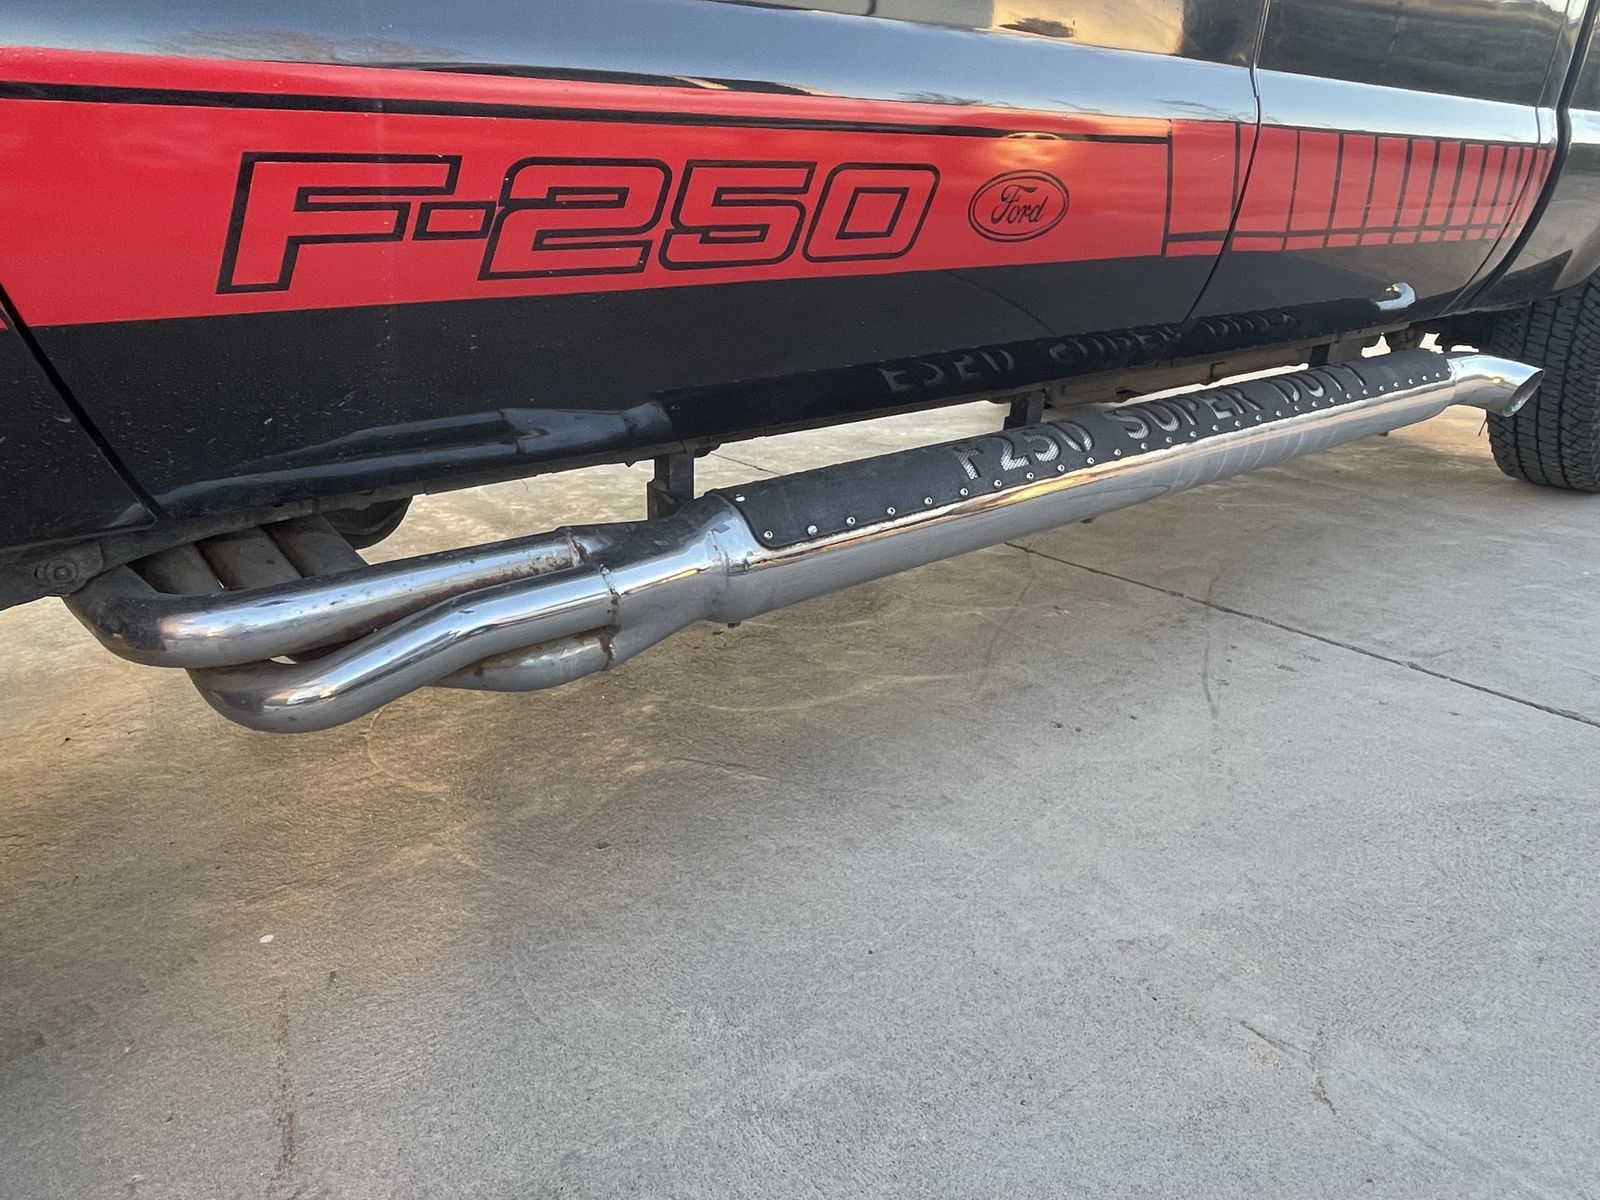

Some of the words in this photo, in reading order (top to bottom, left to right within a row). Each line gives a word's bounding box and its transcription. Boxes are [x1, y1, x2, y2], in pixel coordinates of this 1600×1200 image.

[216, 151, 940, 295] F-250
[990, 184, 1049, 224] Ford
[1101, 387, 1262, 440] SUPER
